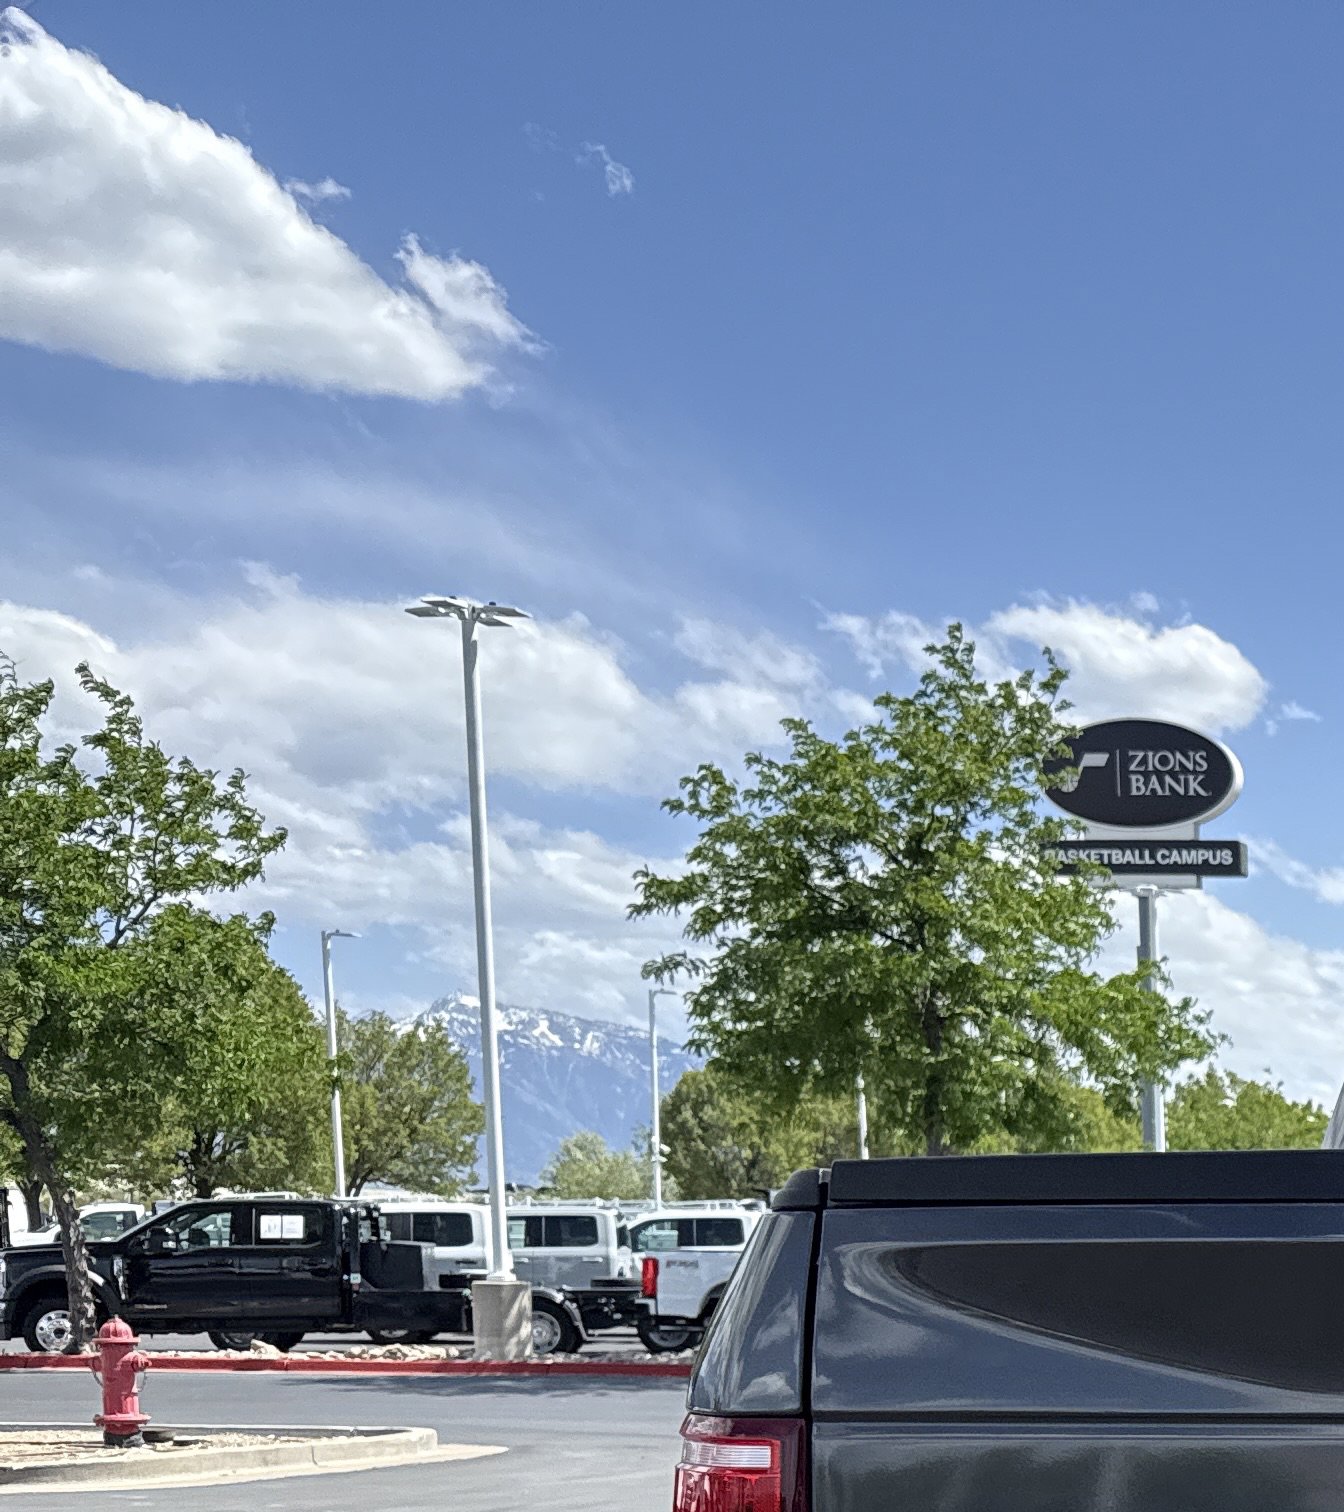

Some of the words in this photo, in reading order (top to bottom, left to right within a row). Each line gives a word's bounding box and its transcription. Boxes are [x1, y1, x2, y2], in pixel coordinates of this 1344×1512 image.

[1128, 750, 1208, 772] ZIONS
[1128, 773, 1210, 797] BANK
[1156, 848, 1233, 866] CAMPUS
